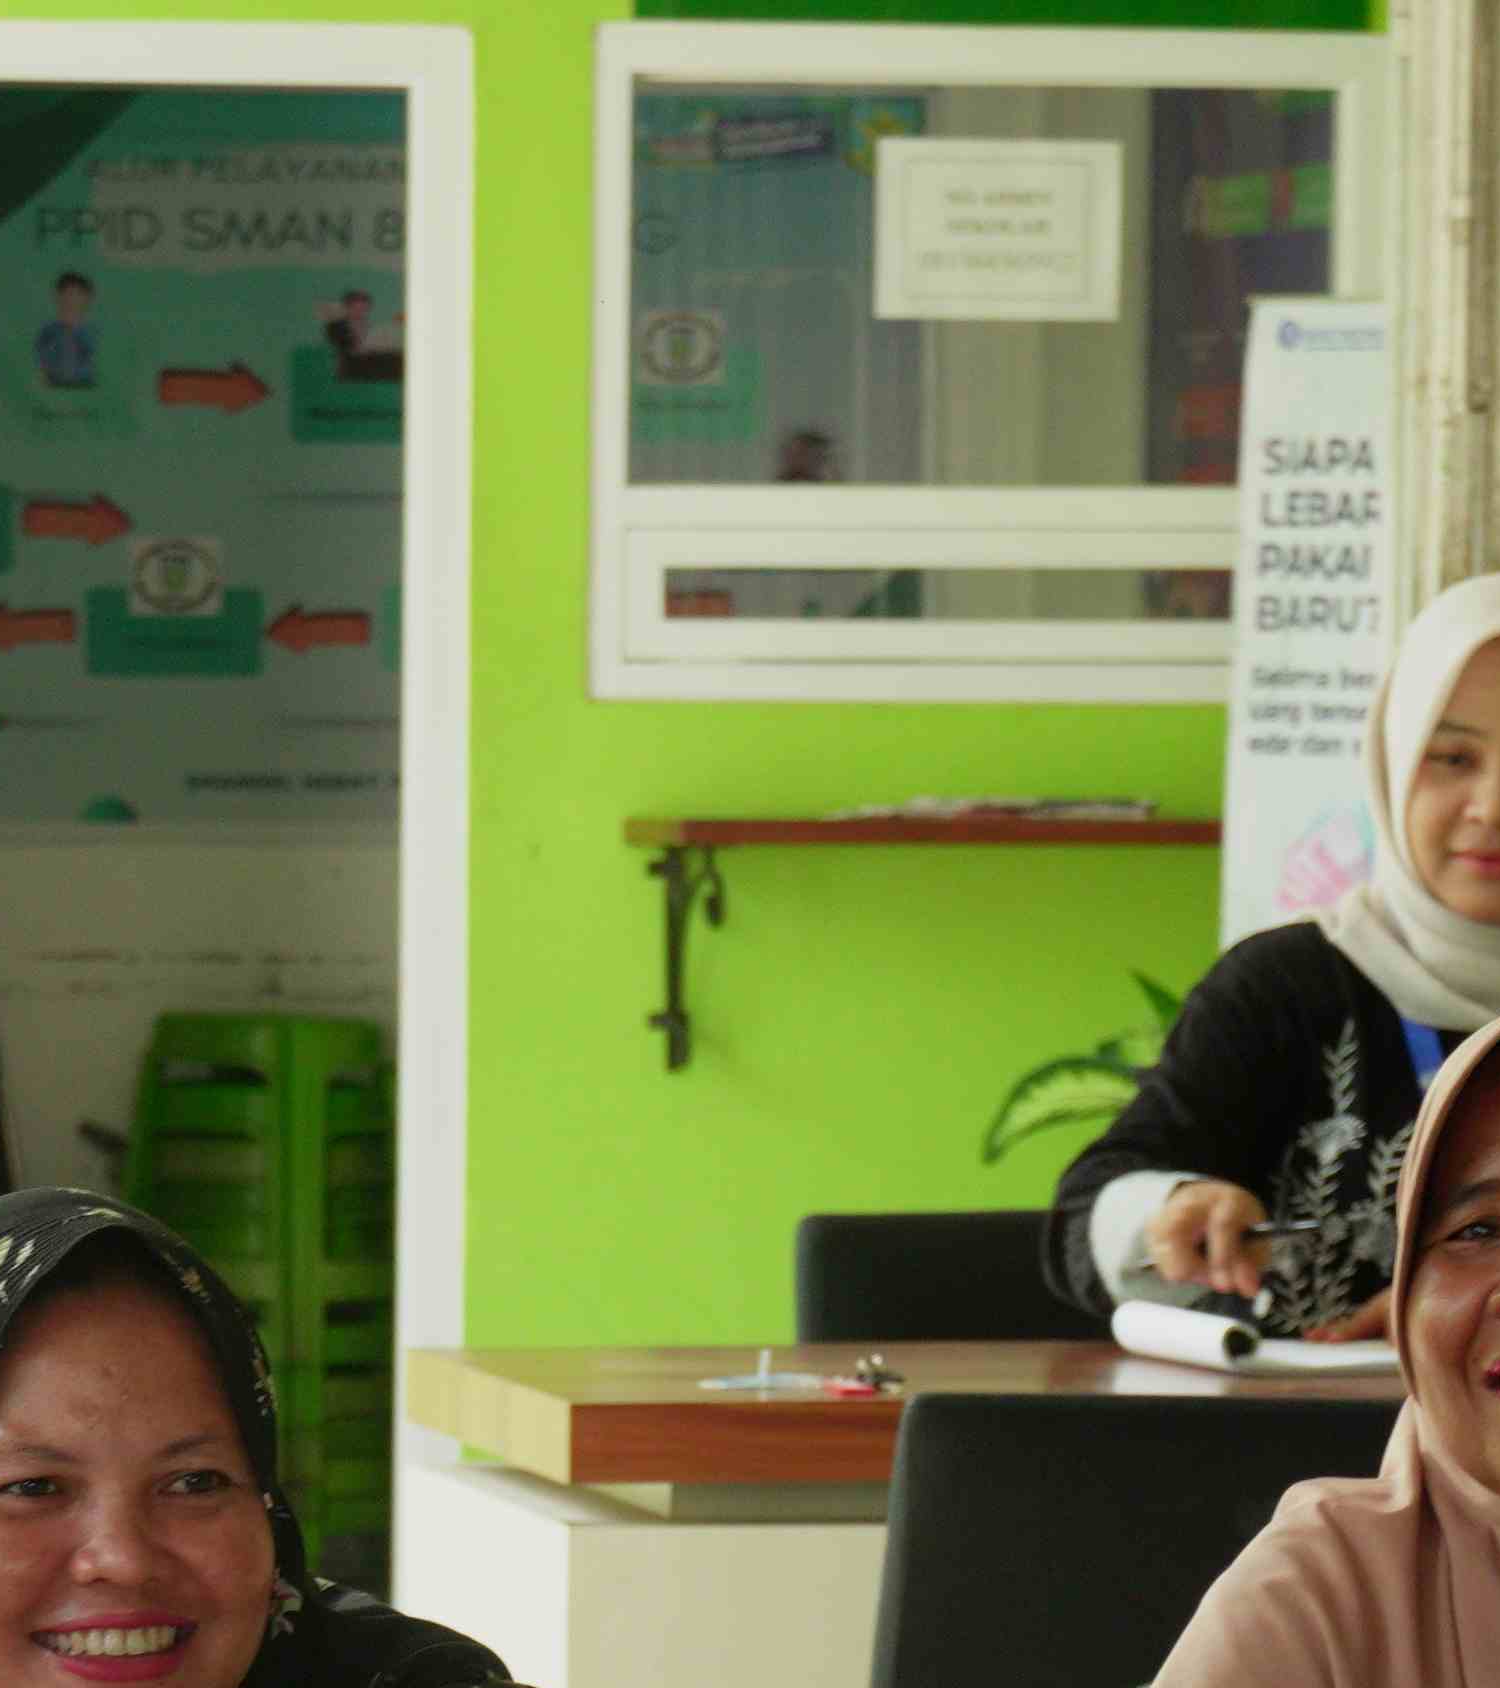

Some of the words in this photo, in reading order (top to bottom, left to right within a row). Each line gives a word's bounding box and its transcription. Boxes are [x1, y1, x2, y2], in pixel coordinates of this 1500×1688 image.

[34, 206, 163, 252] PPID
[178, 206, 353, 252] SMAN
[1261, 435, 1375, 476] SIAPA
[1256, 543, 1373, 579] PAKAI
